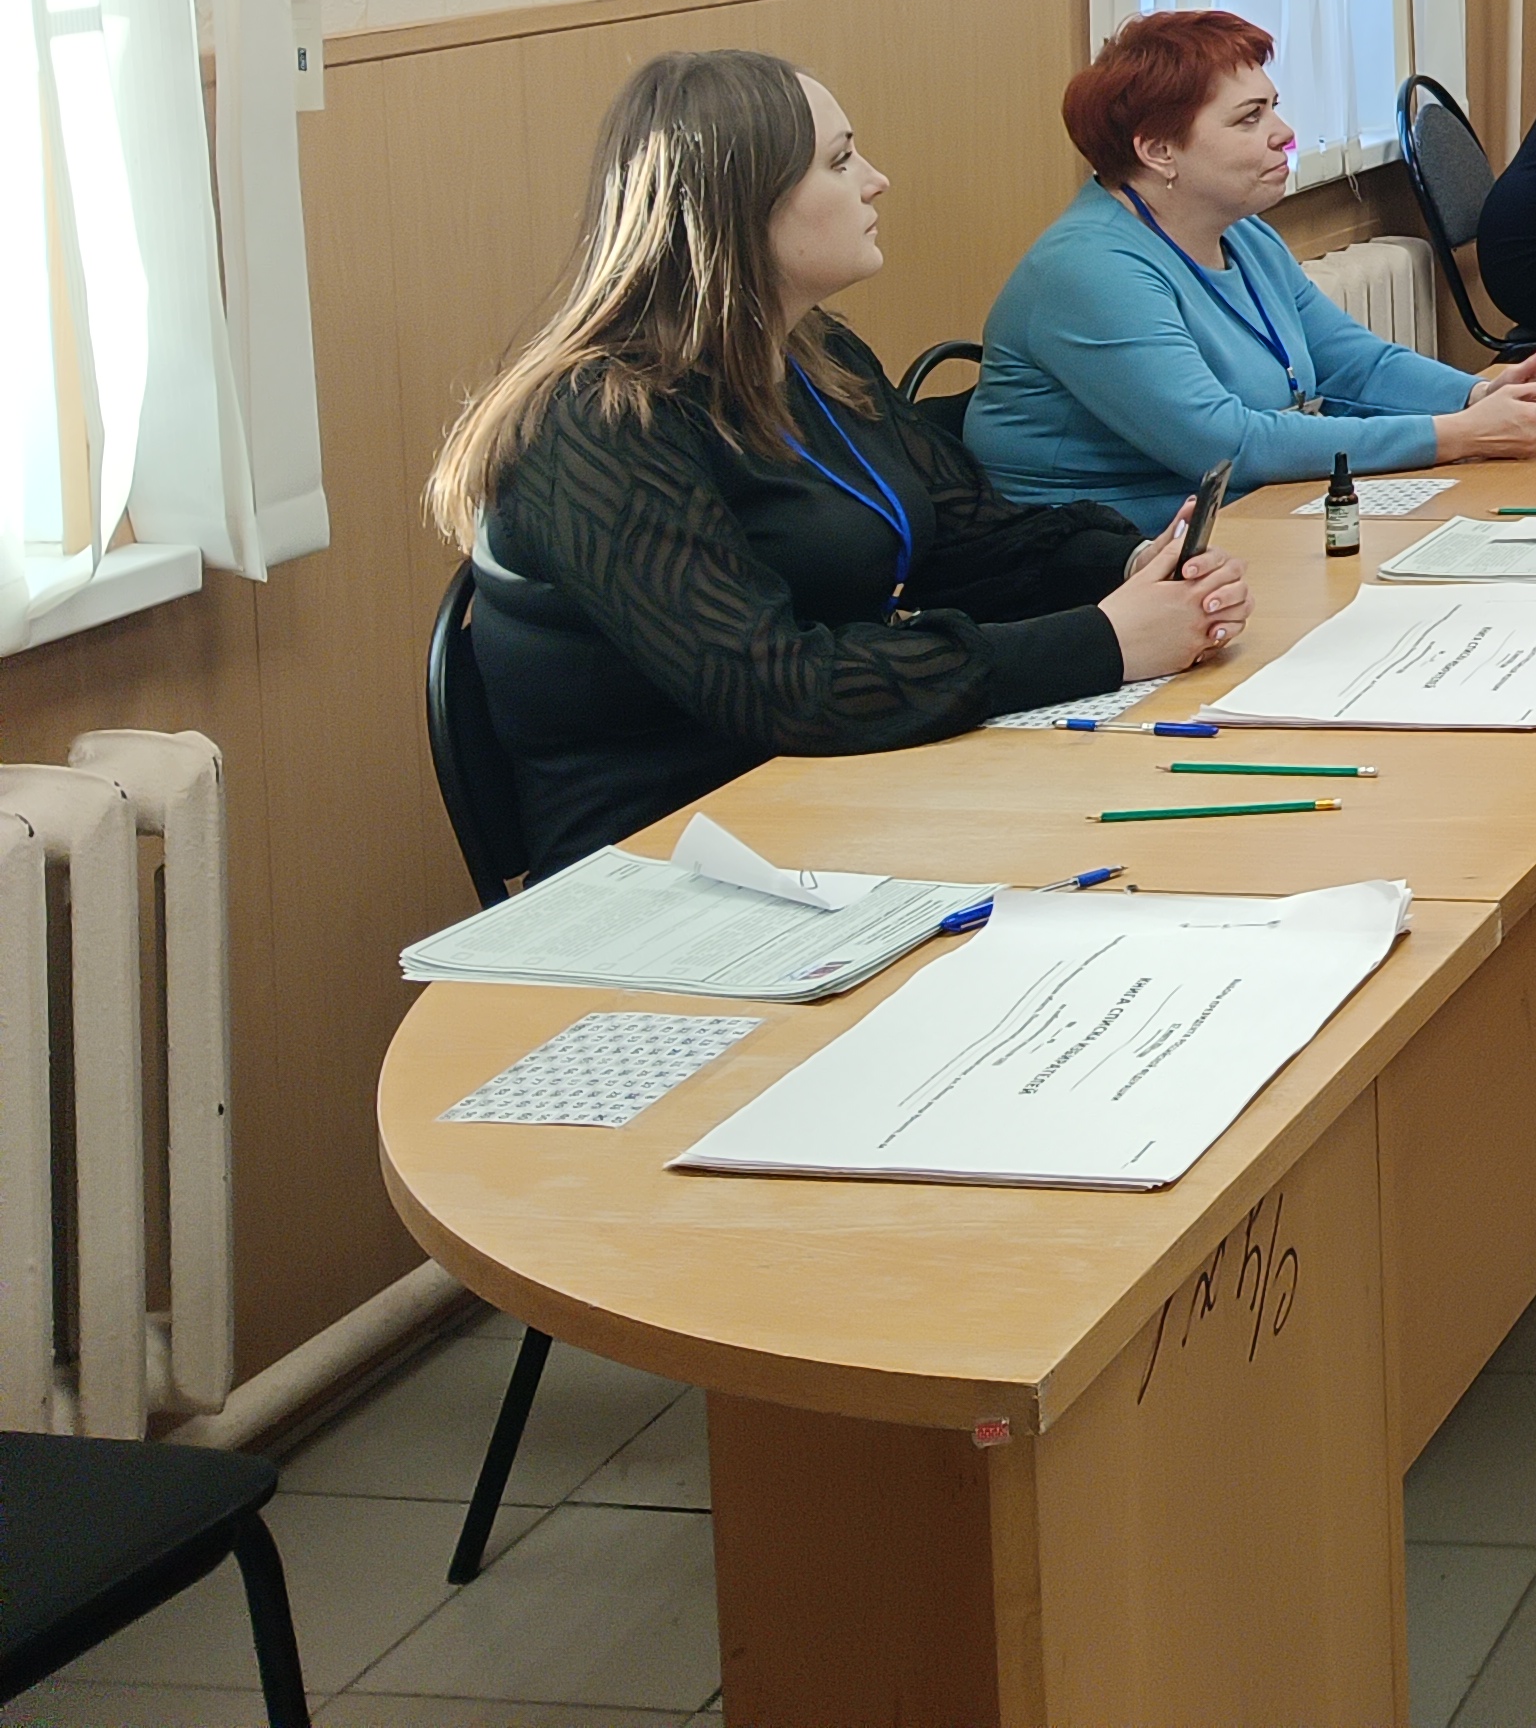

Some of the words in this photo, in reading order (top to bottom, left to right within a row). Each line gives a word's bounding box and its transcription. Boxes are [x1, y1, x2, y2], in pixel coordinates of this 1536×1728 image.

[1116, 977, 1153, 1006] КНИГА
[1082, 1007, 1124, 1042] СПИСКА
[1018, 1042, 1090, 1095] ИЗБИРАТЕЛЕЙ
